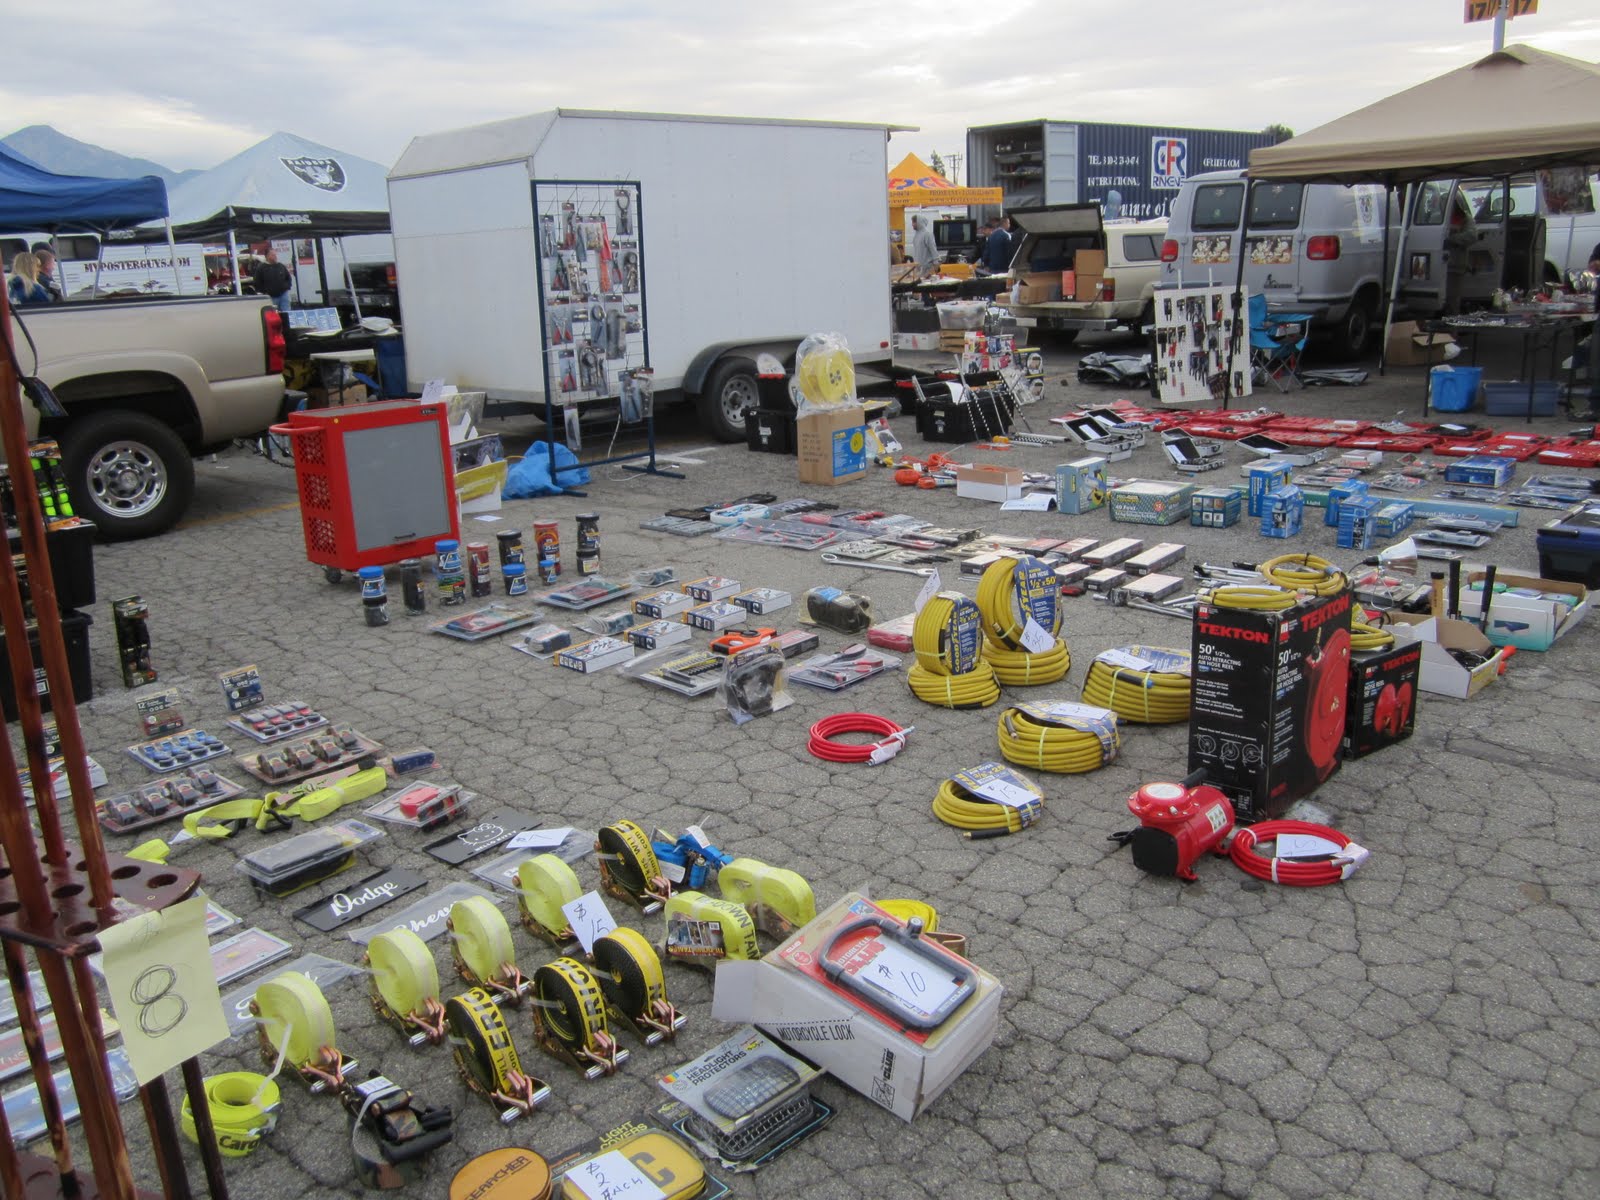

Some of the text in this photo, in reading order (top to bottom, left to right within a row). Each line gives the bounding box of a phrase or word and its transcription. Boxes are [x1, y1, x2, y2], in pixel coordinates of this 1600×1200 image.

[287, 157, 332, 166] RAIDERS
[1154, 140, 1187, 176] CFR
[252, 214, 312, 225] RAIDERS
[1301, 595, 1350, 632] TEKTON
[952, 611, 961, 672] GOODYEAR
[1198, 622, 1269, 645] TEKTON
[1212, 657, 1241, 667] RETRACTING
[475, 838, 498, 851] HELLO
[330, 881, 398, 917] Dodge
[574, 902, 588, 922] $
[901, 970, 926, 997] 10
[777, 1024, 855, 1042] MOTORCYCLE LOCK
[686, 1050, 735, 1082] HEADLIGHT
[692, 1051, 748, 1086] PROTECTORS
[599, 1121, 634, 1143] LIGHT
[600, 1123, 648, 1149] COVERS
[595, 1172, 610, 1188] 2
